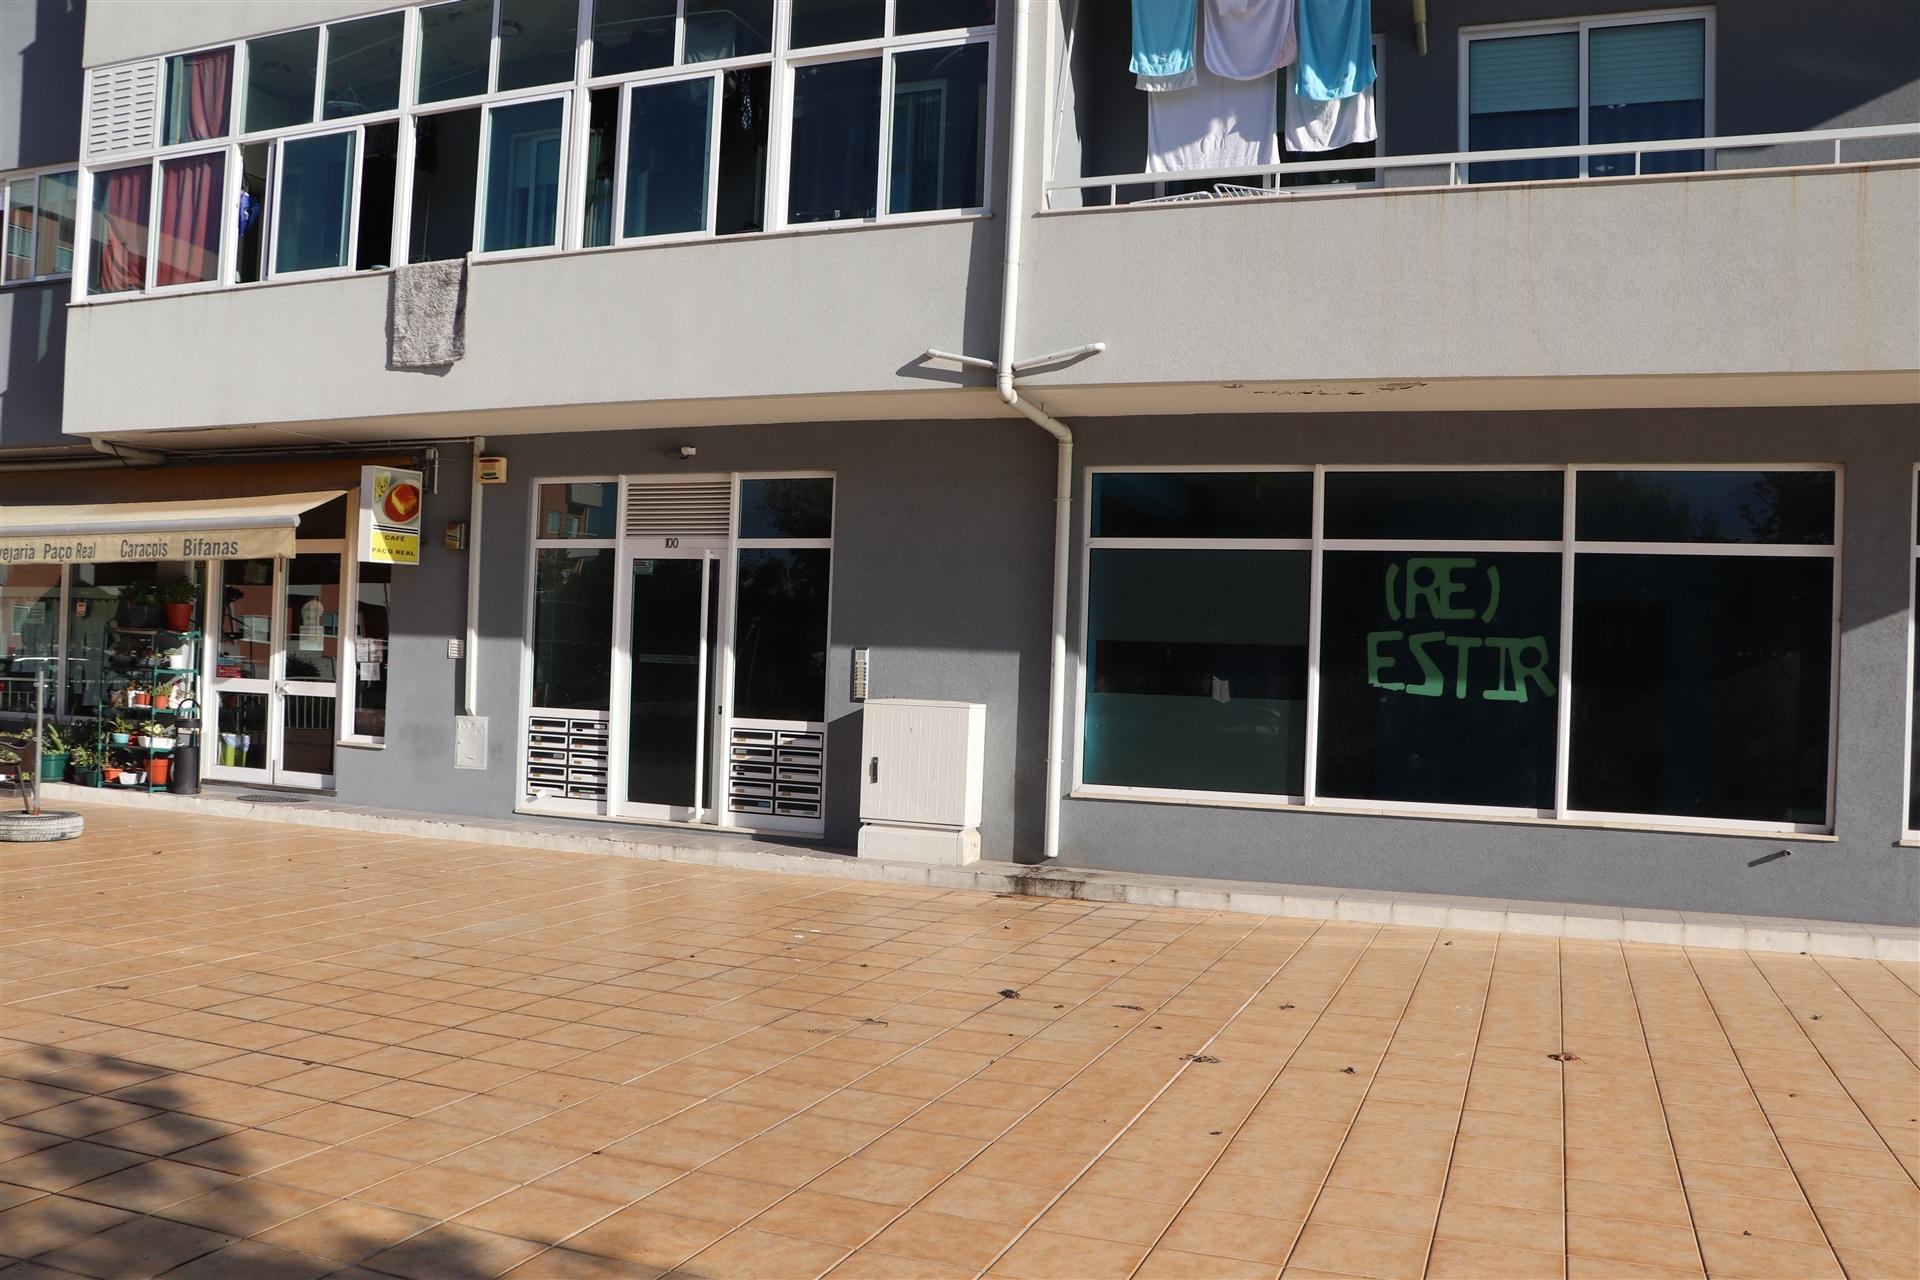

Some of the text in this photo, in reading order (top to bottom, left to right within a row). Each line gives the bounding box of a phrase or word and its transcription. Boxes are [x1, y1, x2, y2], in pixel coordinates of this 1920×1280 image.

[43, 543, 73, 562] Paço
[75, 542, 97, 559] Real
[182, 538, 239, 557] Bifanas
[665, 537, 679, 549] 100
